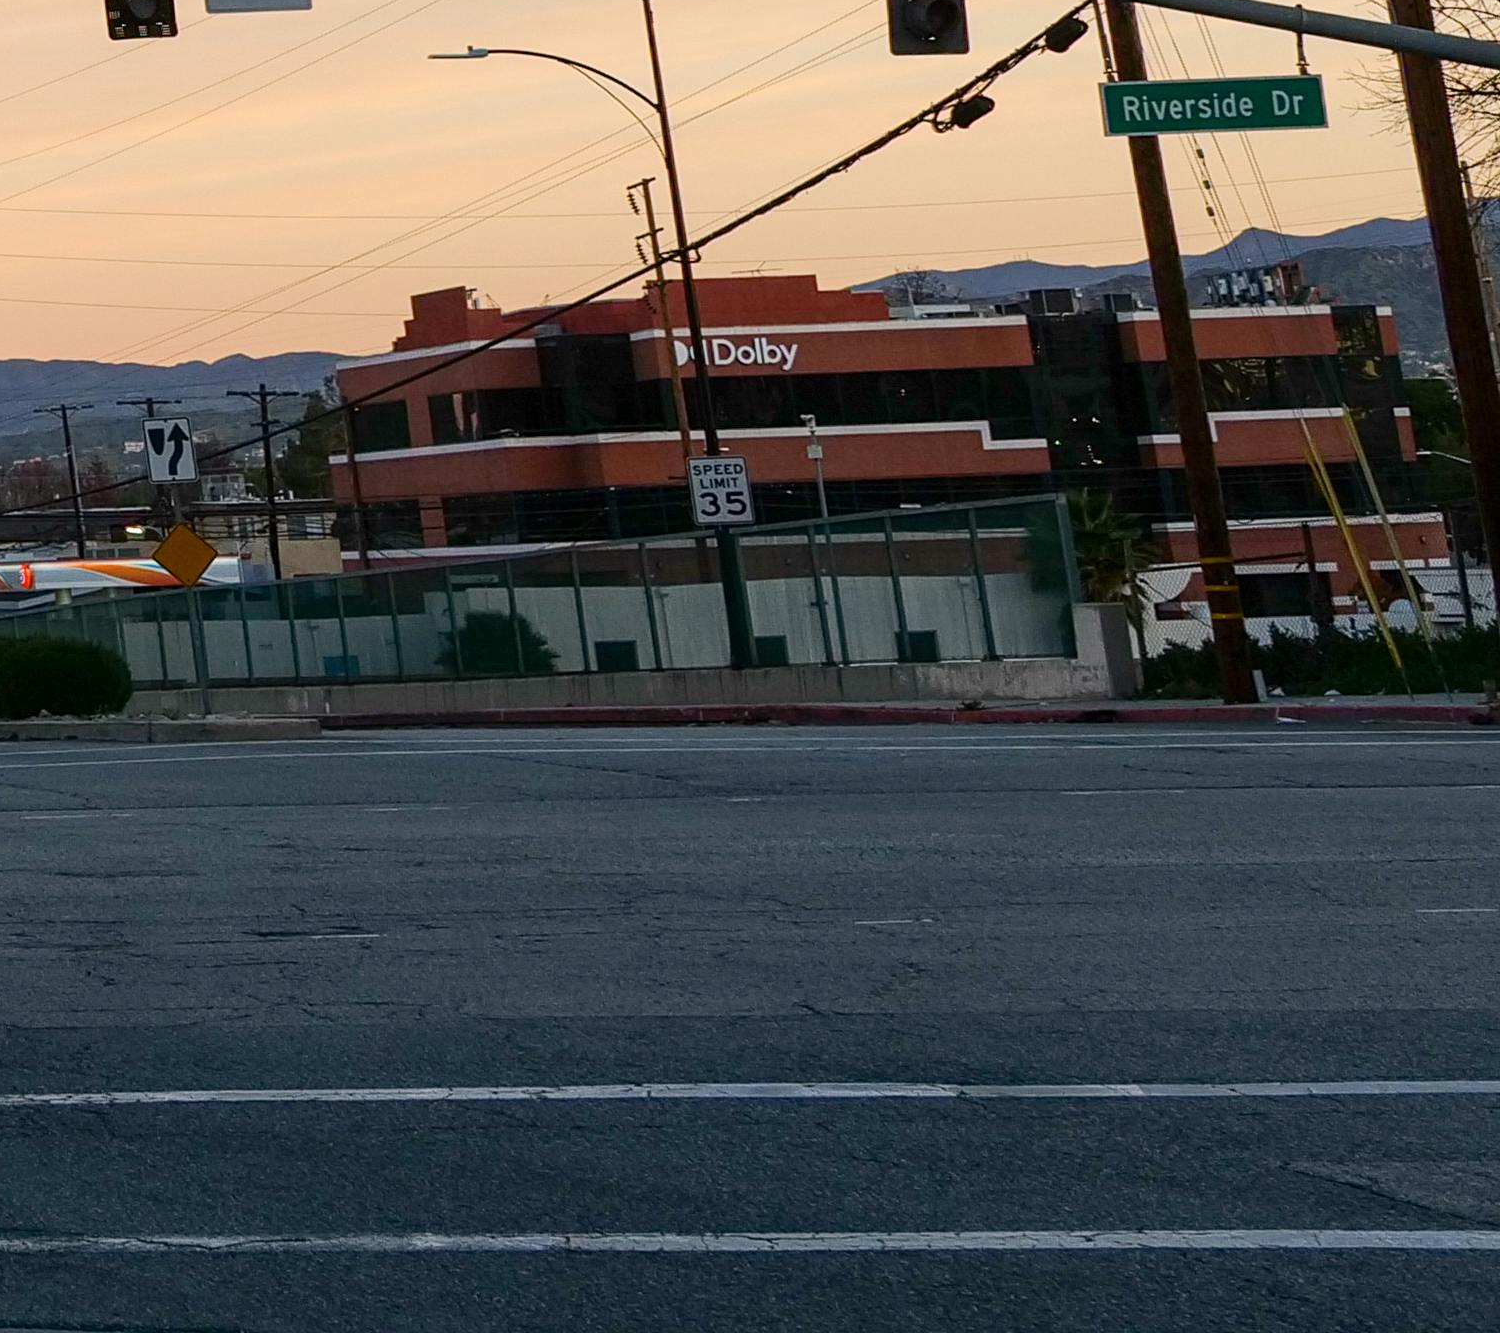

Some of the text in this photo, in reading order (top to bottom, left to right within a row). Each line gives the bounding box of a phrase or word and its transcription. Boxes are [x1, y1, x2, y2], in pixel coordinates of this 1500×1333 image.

[1122, 89, 1304, 122] Riverside Dr
[711, 337, 798, 370] Dolby
[693, 464, 744, 477] SPEED
[700, 477, 740, 489] LIMIT
[700, 491, 747, 516] 35
